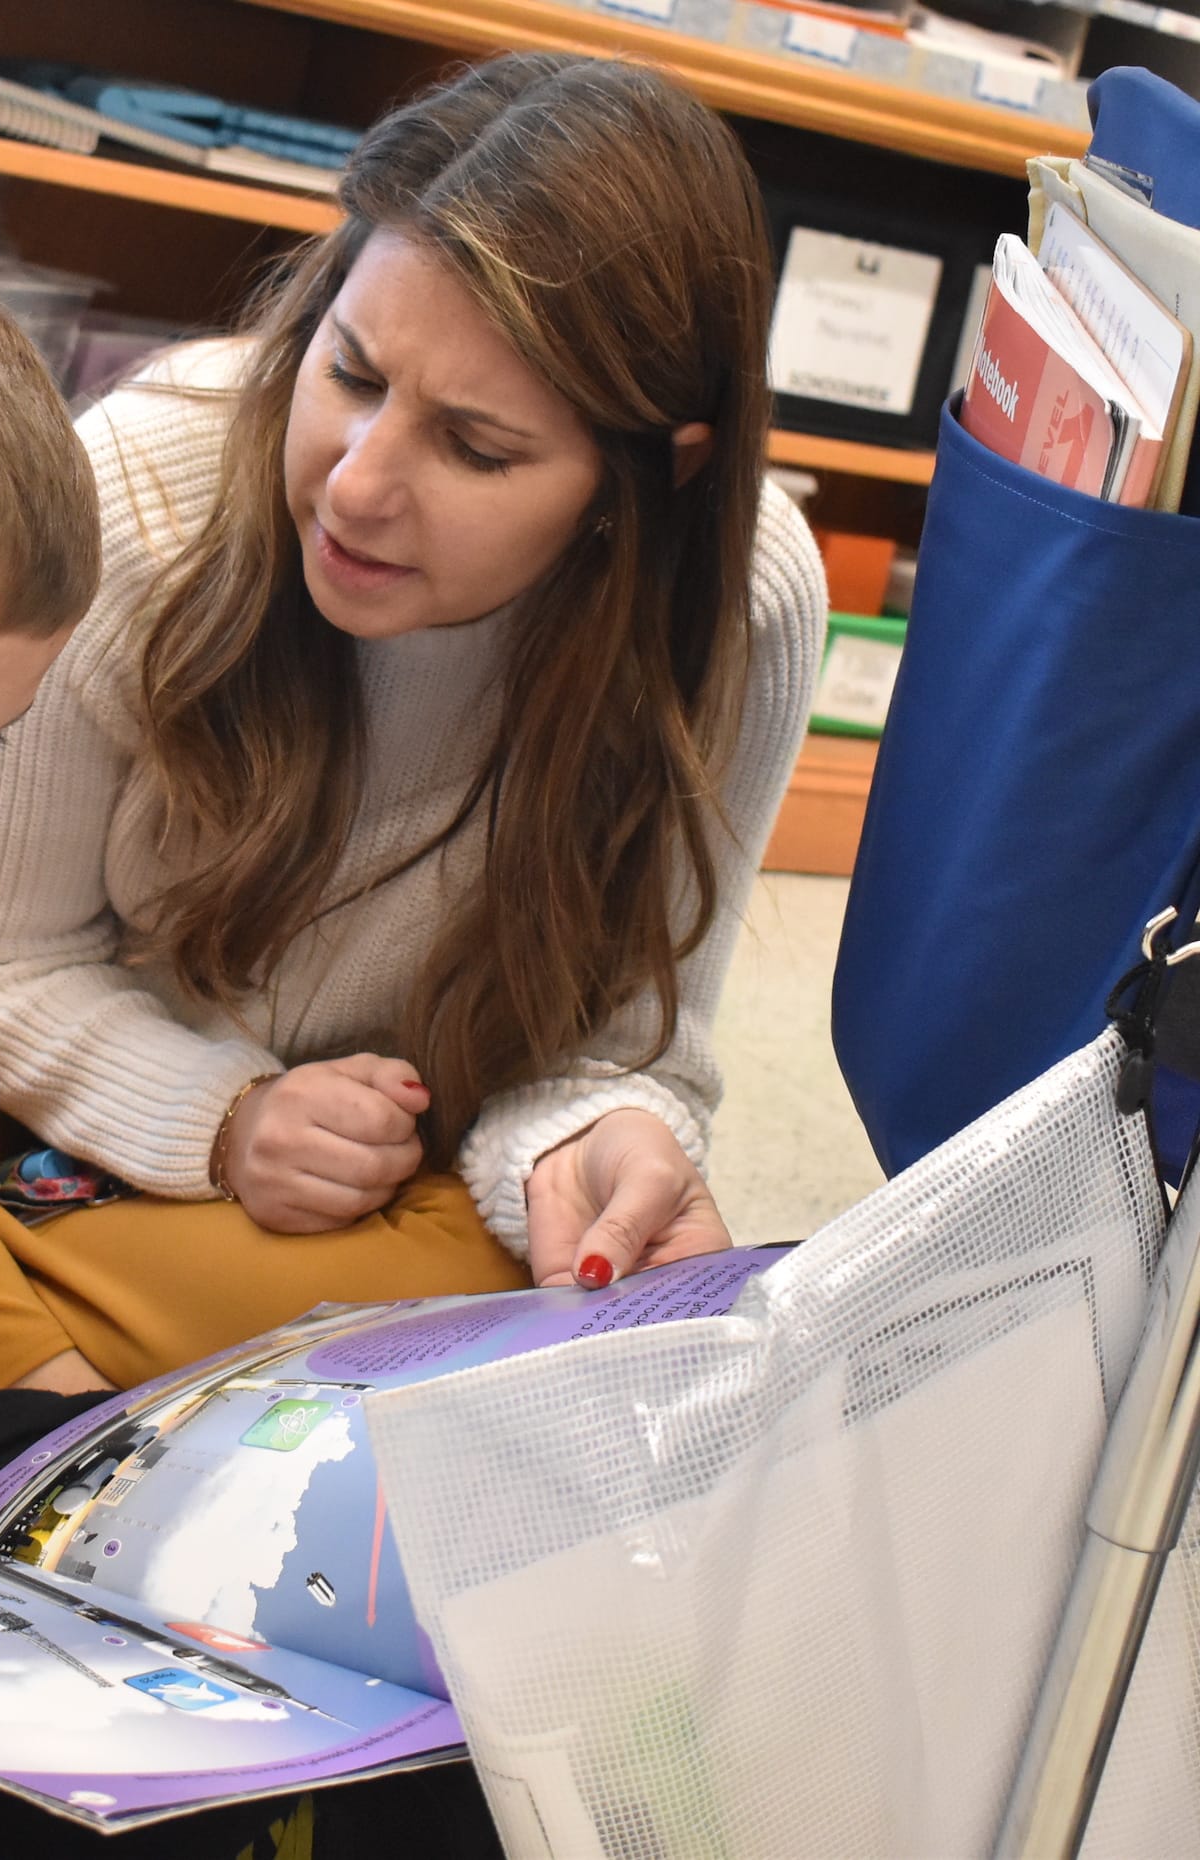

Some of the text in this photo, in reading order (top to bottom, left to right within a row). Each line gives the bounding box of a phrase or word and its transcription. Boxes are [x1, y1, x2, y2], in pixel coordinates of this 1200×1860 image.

[1038, 389, 1069, 474] EVEL
[657, 1283, 683, 1301] the
[661, 1300, 690, 1319] The
